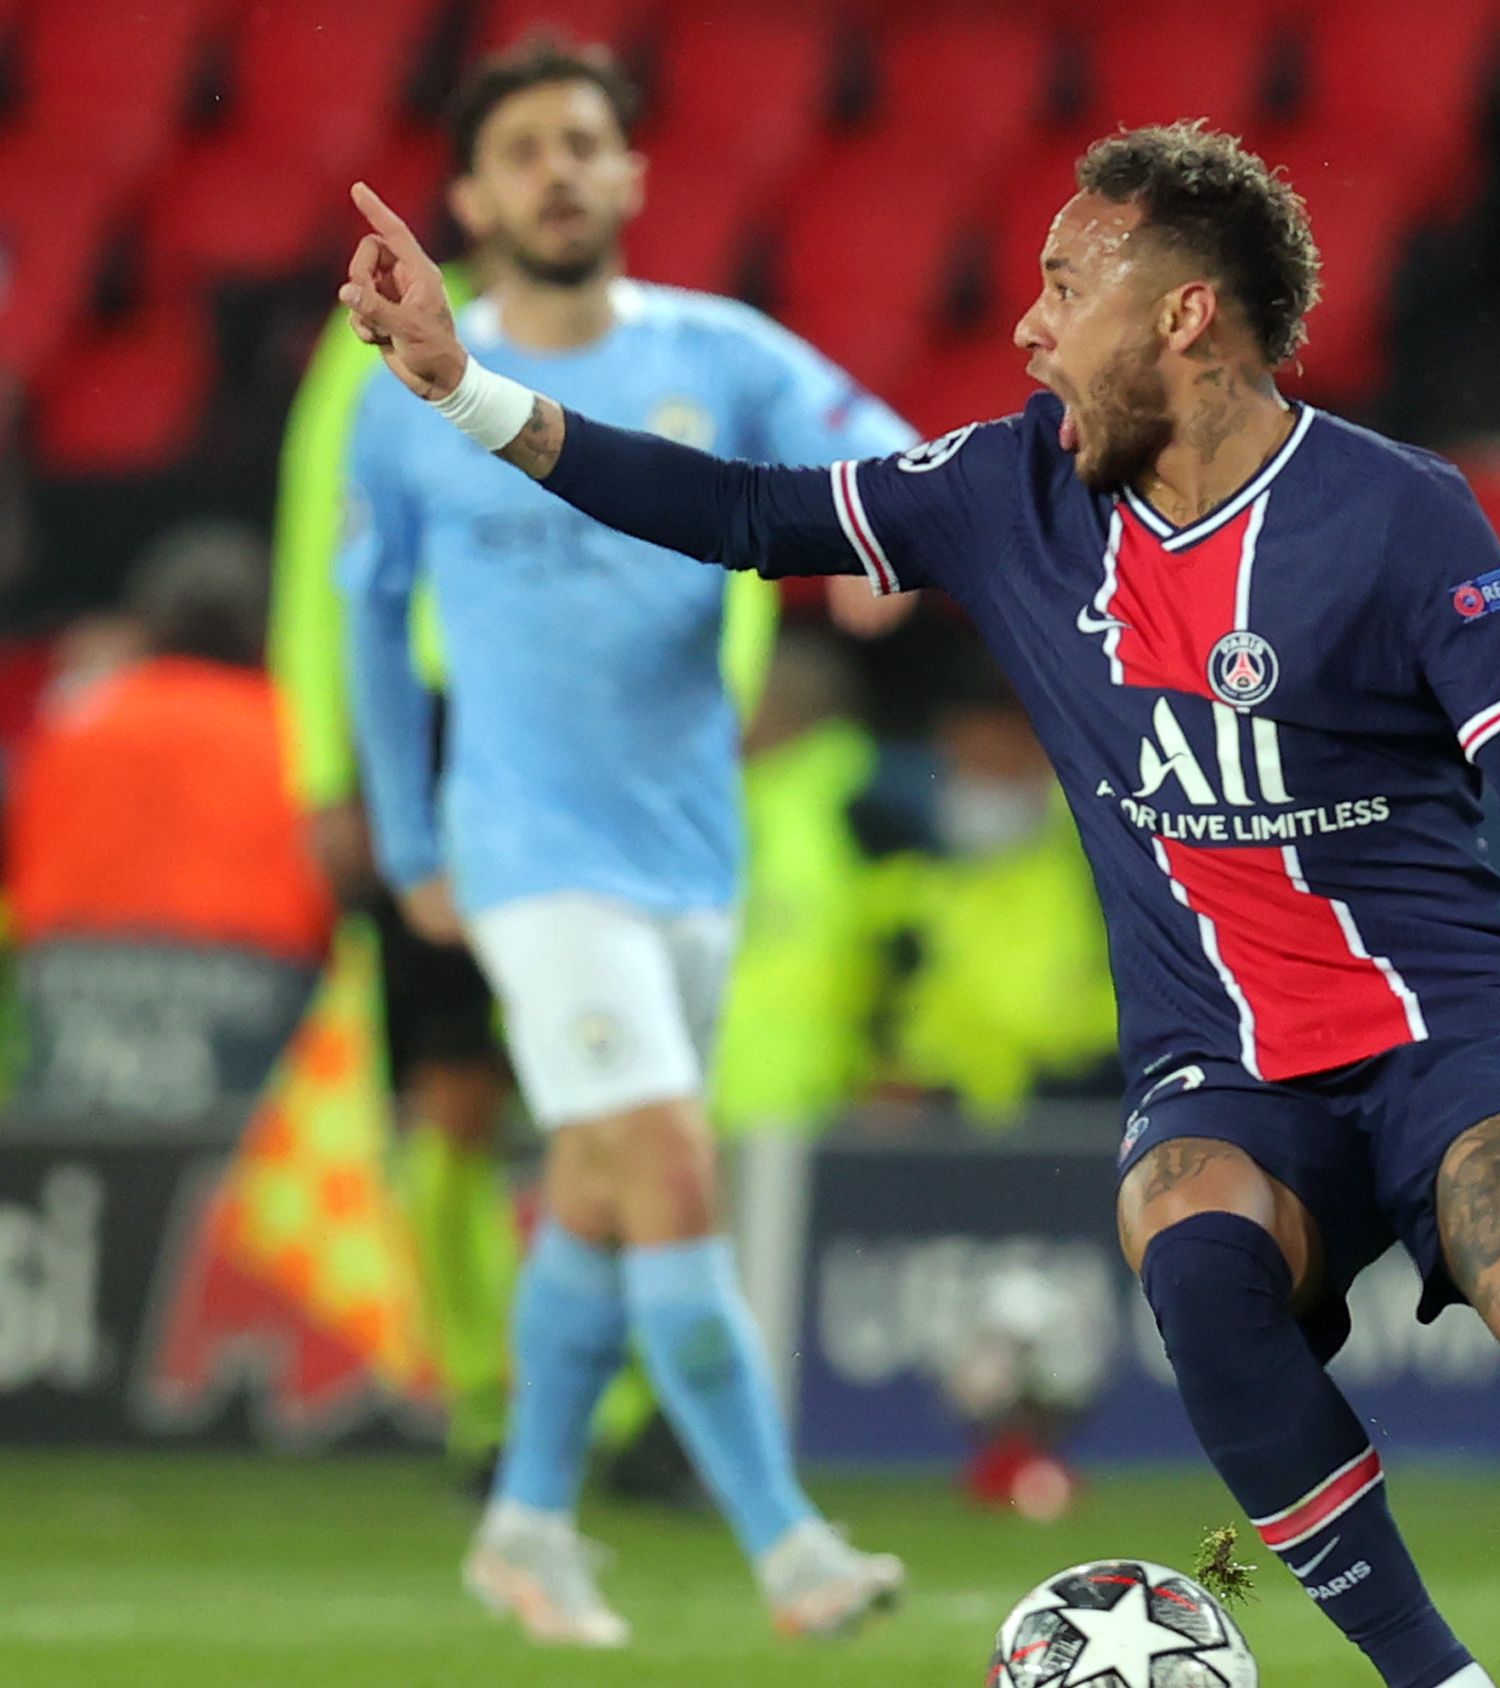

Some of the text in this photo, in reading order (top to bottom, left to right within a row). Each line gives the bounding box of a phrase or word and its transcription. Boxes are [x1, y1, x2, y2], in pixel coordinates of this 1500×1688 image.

[1161, 812, 1230, 841] LIVE
[1232, 796, 1391, 841] LIMITLESS
[1306, 1560, 1372, 1600] PARIS
